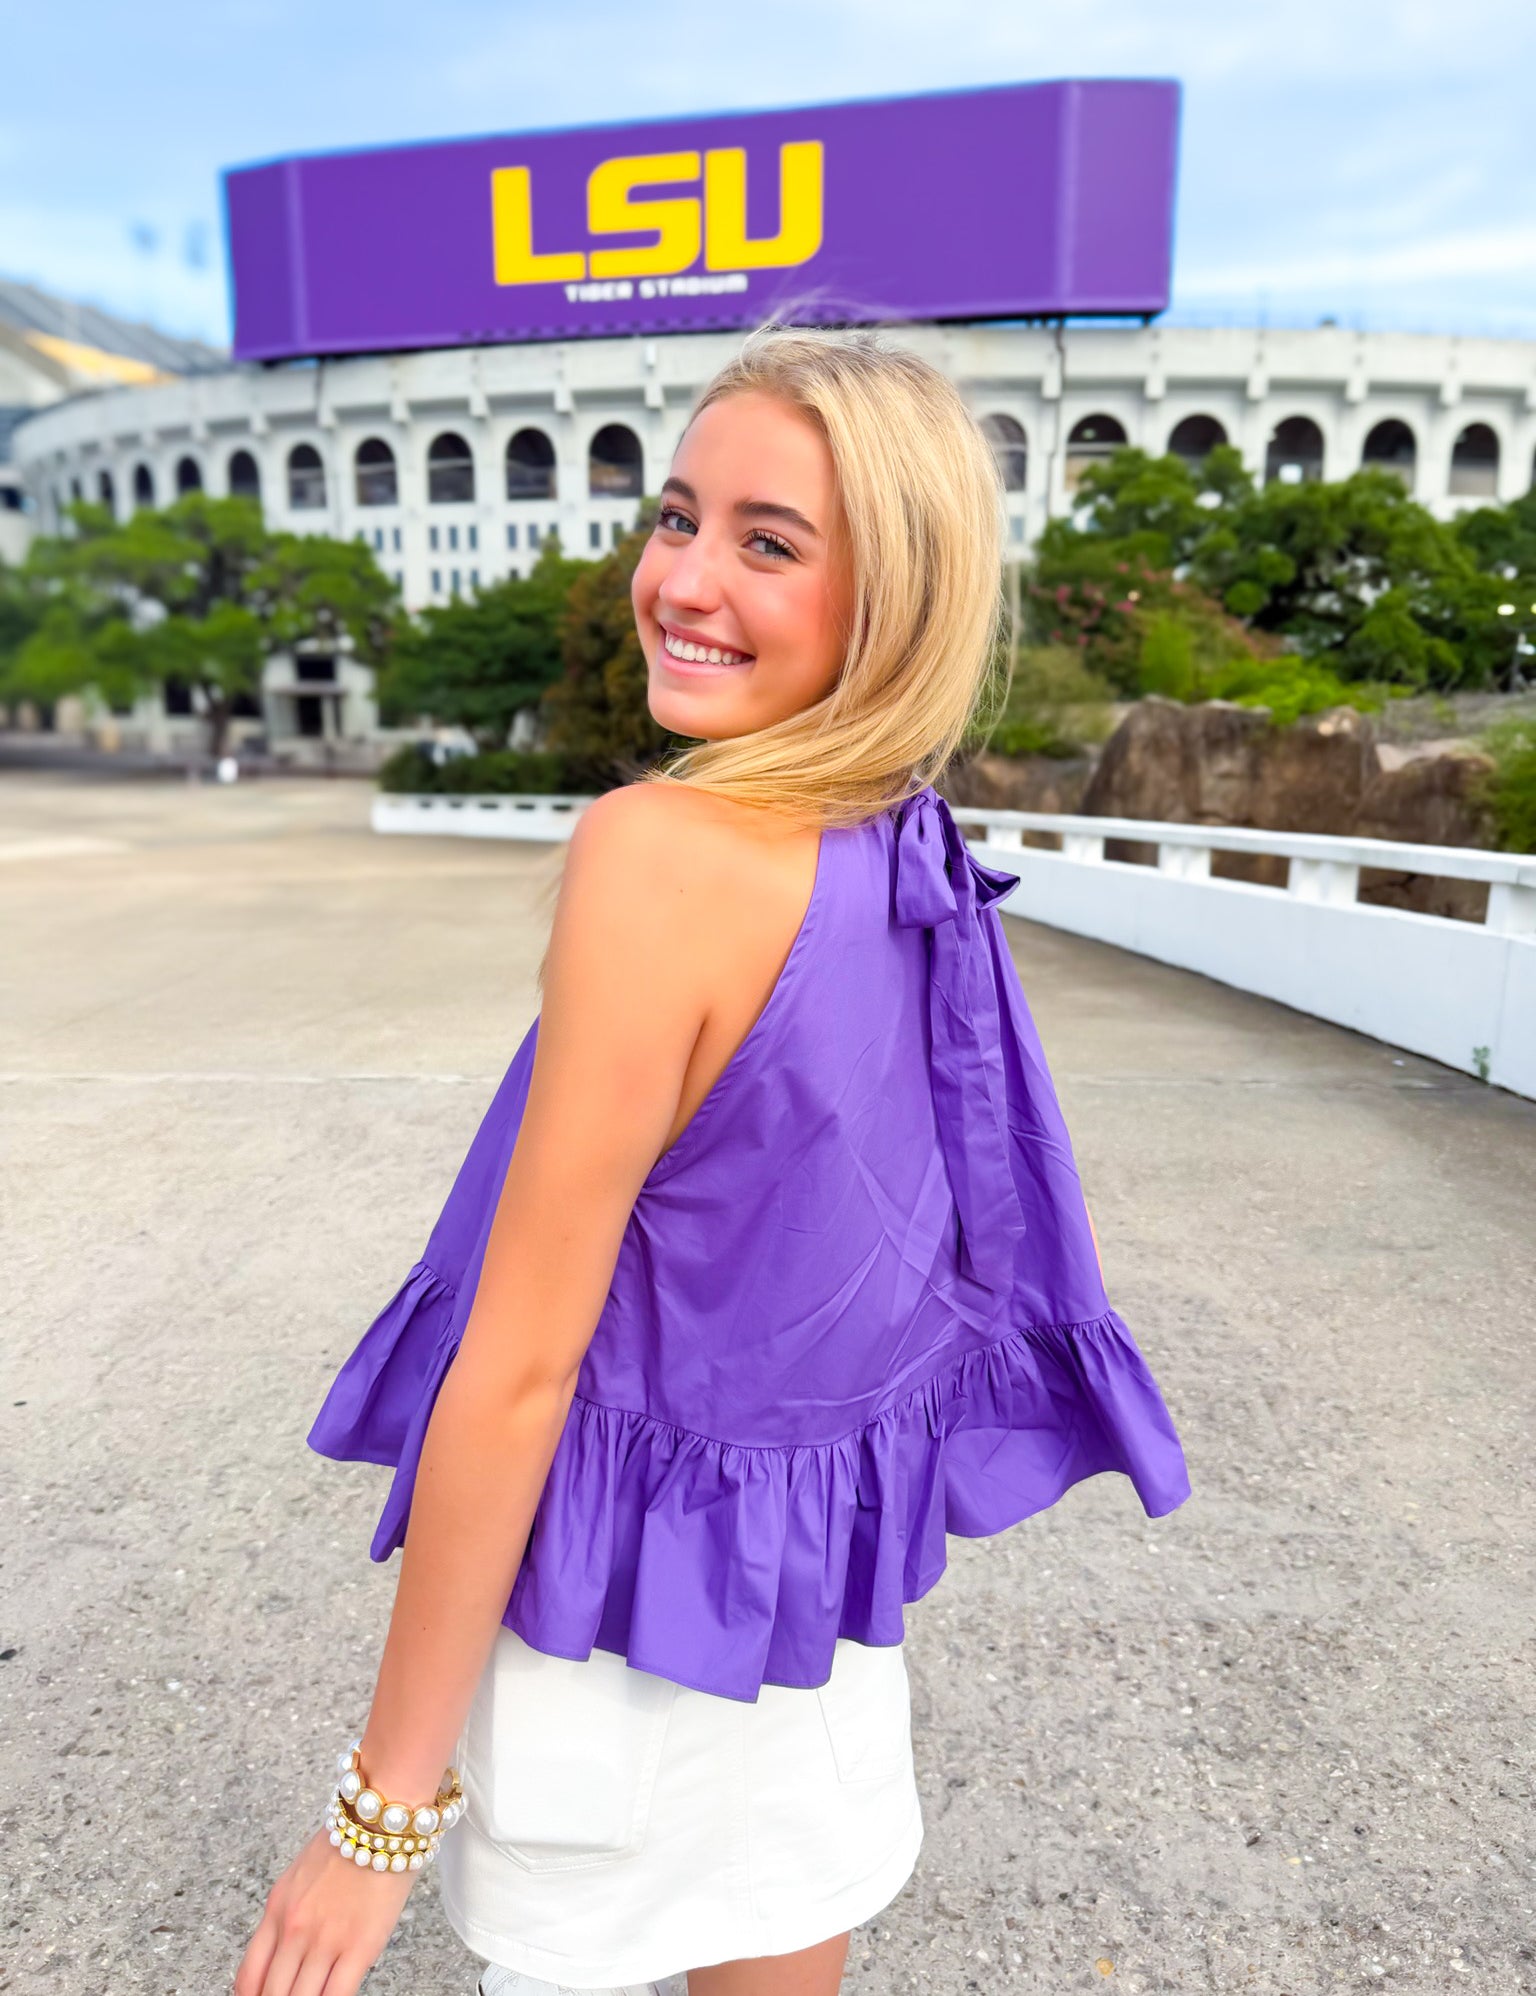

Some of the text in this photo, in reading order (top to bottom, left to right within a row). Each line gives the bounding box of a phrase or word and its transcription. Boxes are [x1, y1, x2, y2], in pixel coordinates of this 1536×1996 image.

[491, 140, 824, 285] LSU
[564, 273, 748, 303] TIGER STADIUM
